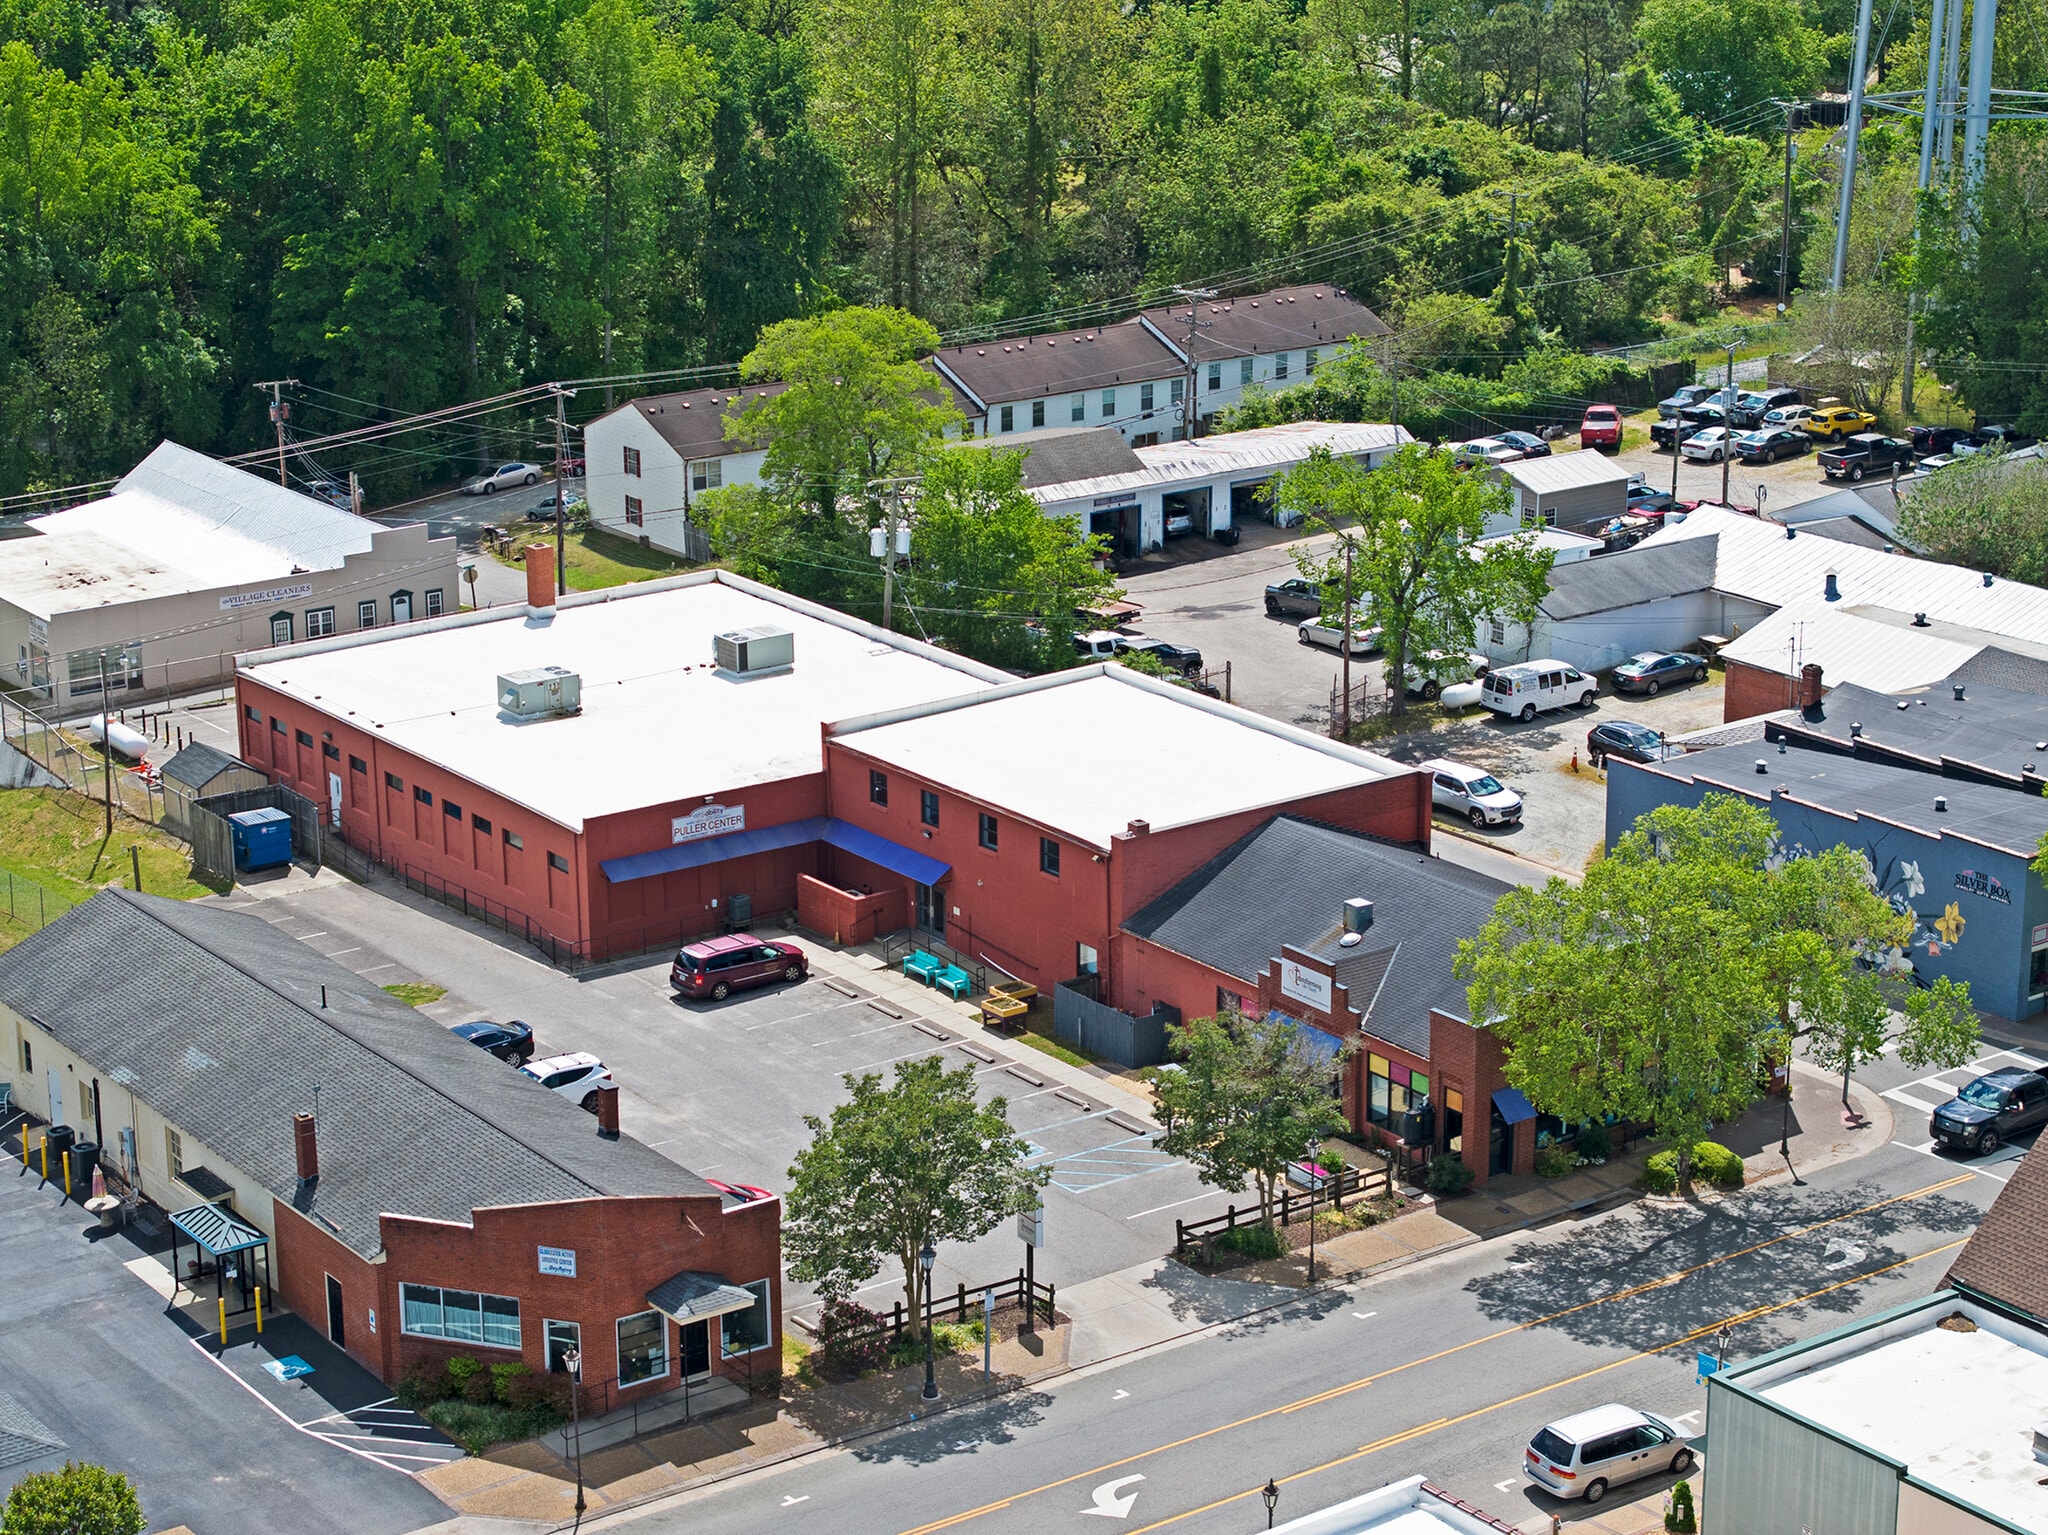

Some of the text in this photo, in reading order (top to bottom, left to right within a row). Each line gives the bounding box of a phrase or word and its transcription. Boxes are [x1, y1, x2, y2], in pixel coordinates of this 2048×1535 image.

[229, 592, 265, 604] VILLAGE
[267, 585, 311, 598] CLEANERS
[674, 822, 707, 837] PULLER
[708, 815, 743, 830] CENTER
[1956, 874, 2011, 900] SILVER BOX
[1975, 872, 1989, 882] THE
